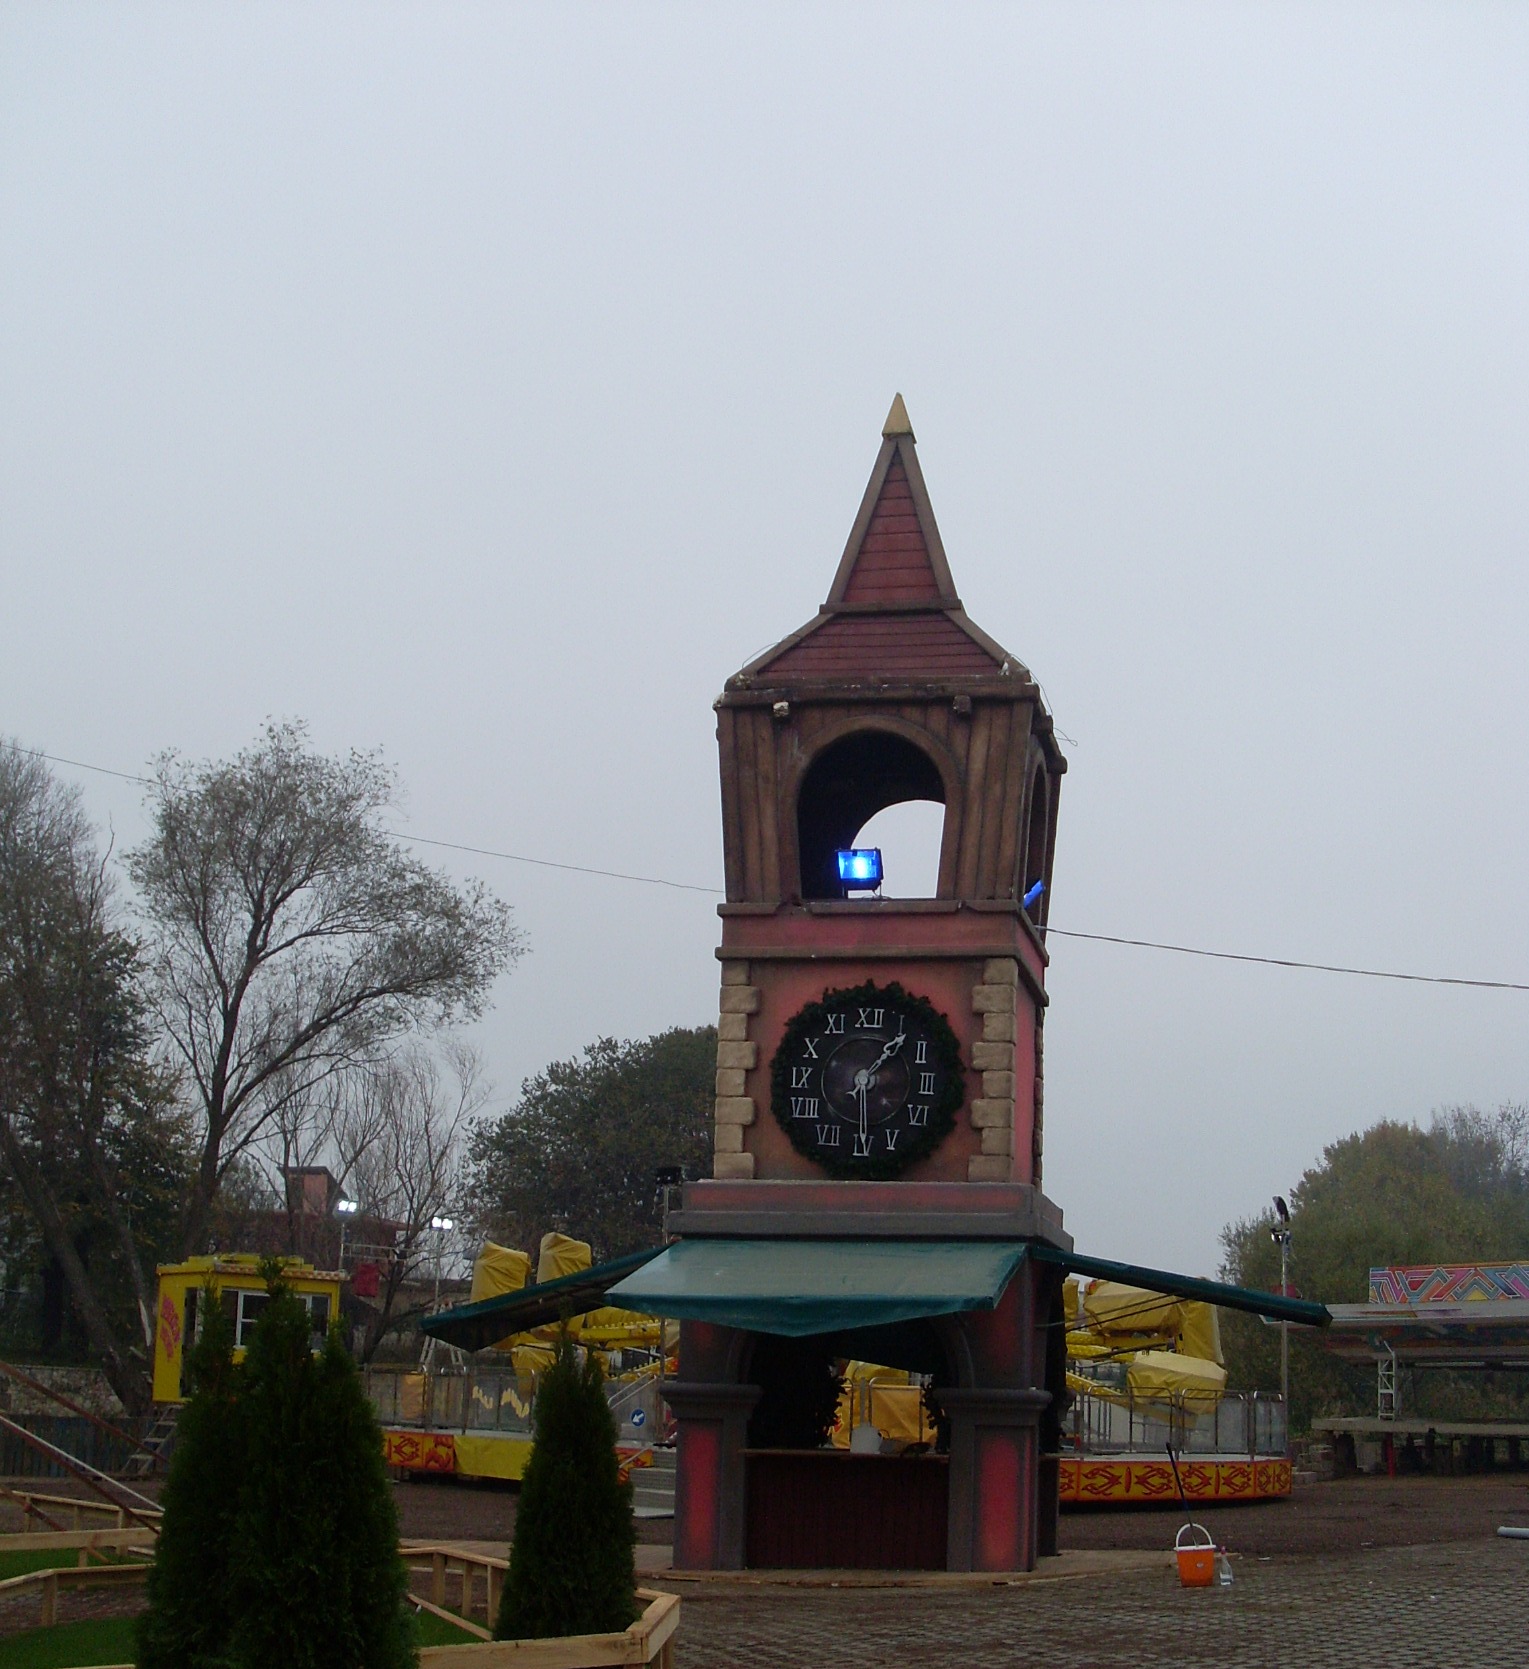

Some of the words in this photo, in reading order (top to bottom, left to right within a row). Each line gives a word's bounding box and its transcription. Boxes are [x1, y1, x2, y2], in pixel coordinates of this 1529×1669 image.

[824, 1014, 845, 1034] XI
[855, 1008, 885, 1028] XII
[803, 1038, 819, 1058] X
[915, 1041, 927, 1063] II
[791, 1067, 813, 1088] IX
[918, 1072, 935, 1094] III
[790, 1097, 819, 1118] VIII
[907, 1104, 929, 1126] VI
[815, 1124, 841, 1146] VII
[885, 1129, 900, 1151] V
